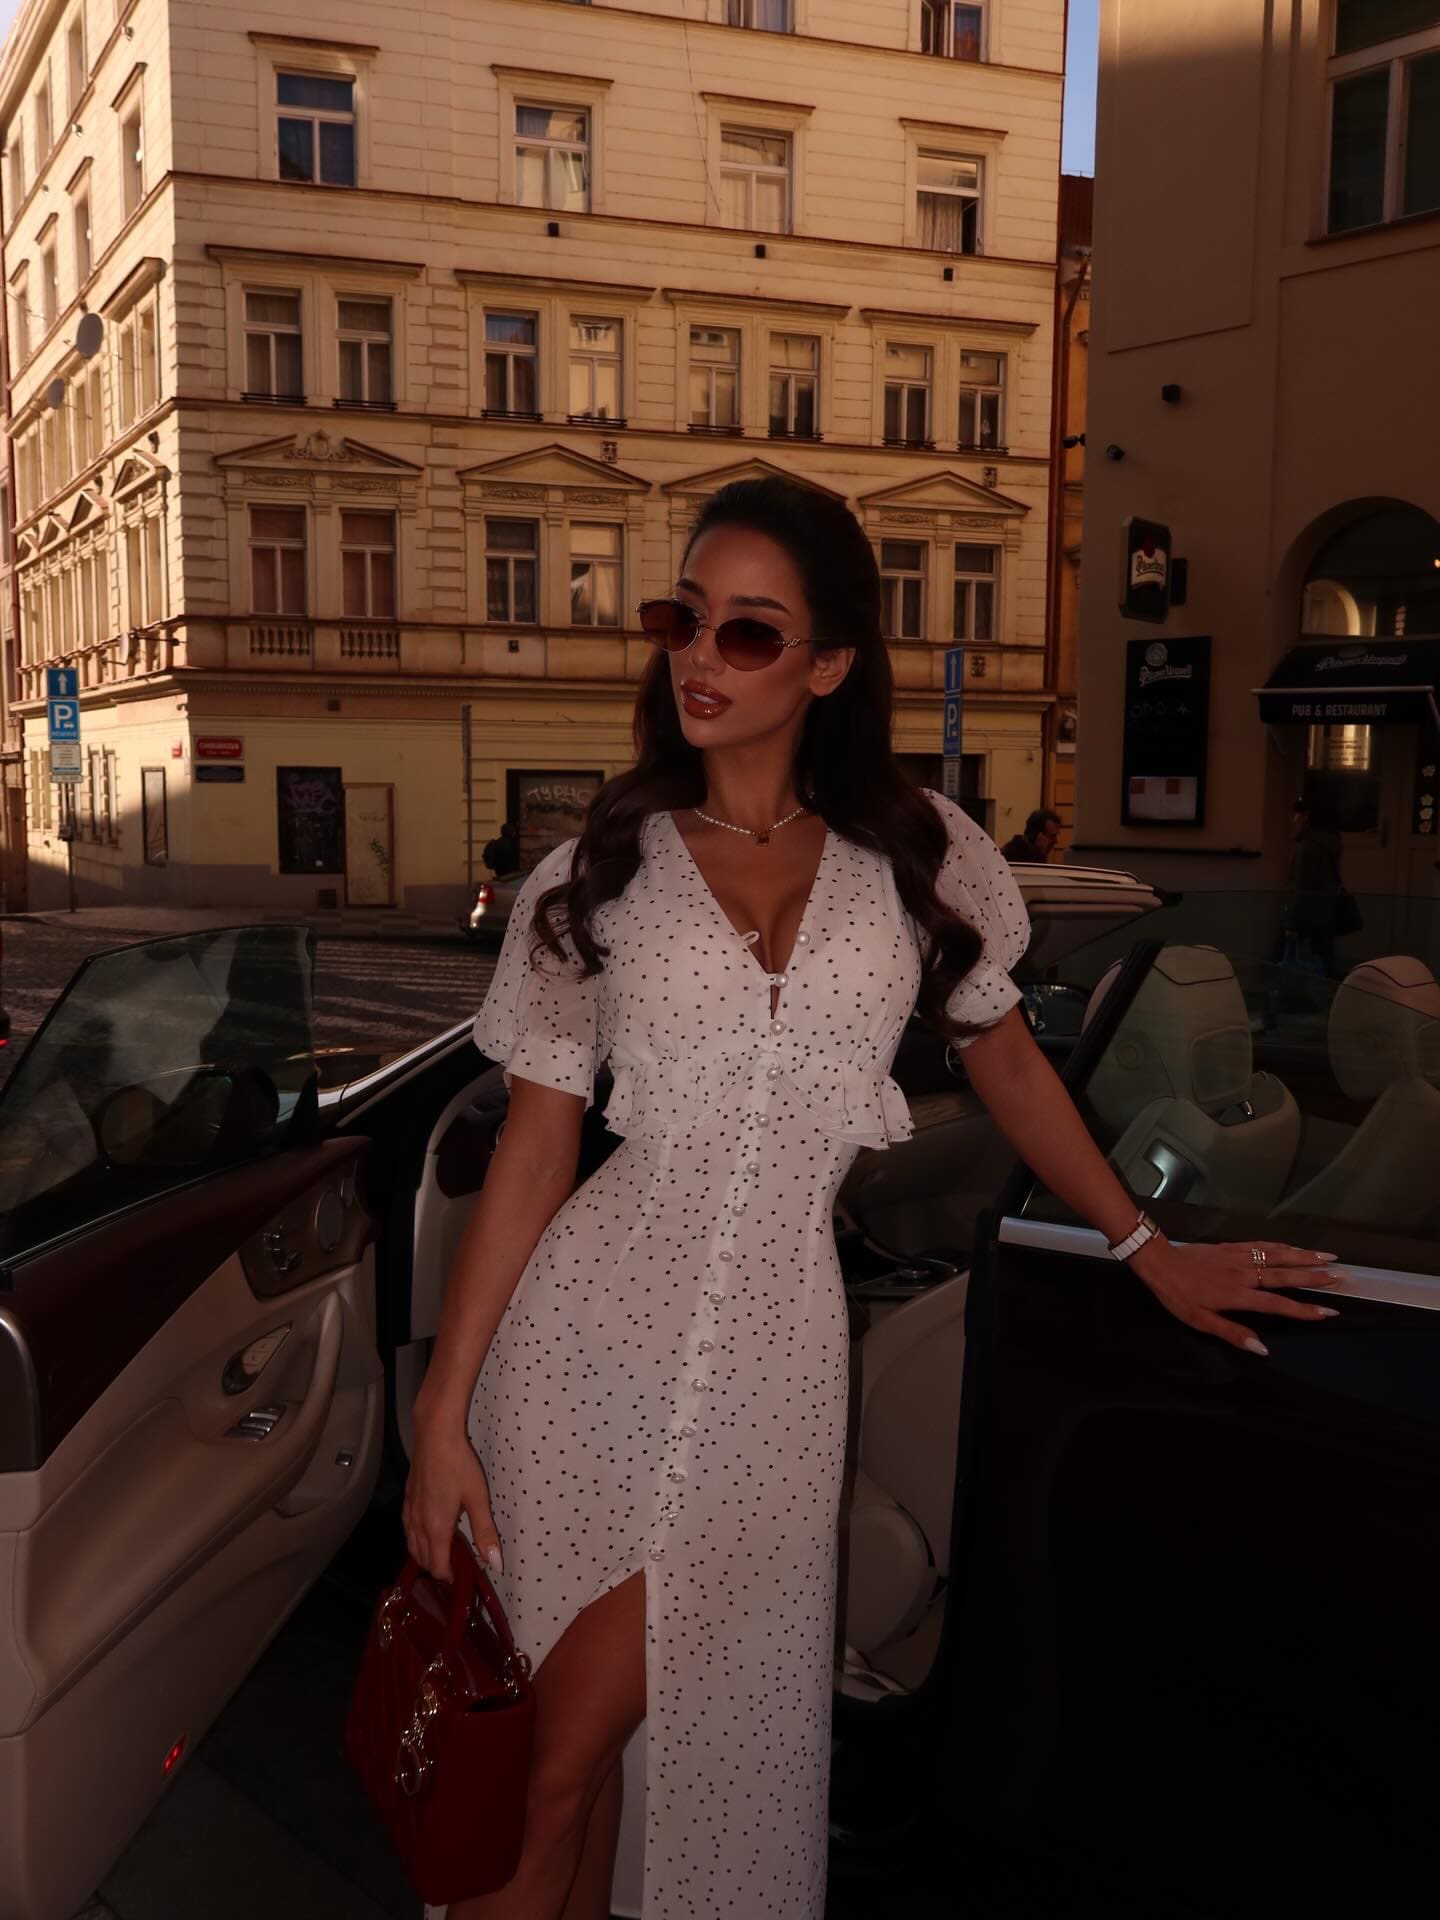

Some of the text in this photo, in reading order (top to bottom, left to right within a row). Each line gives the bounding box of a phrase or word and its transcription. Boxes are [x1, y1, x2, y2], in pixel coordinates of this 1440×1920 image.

[53, 704, 73, 729] P
[947, 703, 957, 738] P
[1291, 703, 1388, 717] PUB & RESTAURANT
